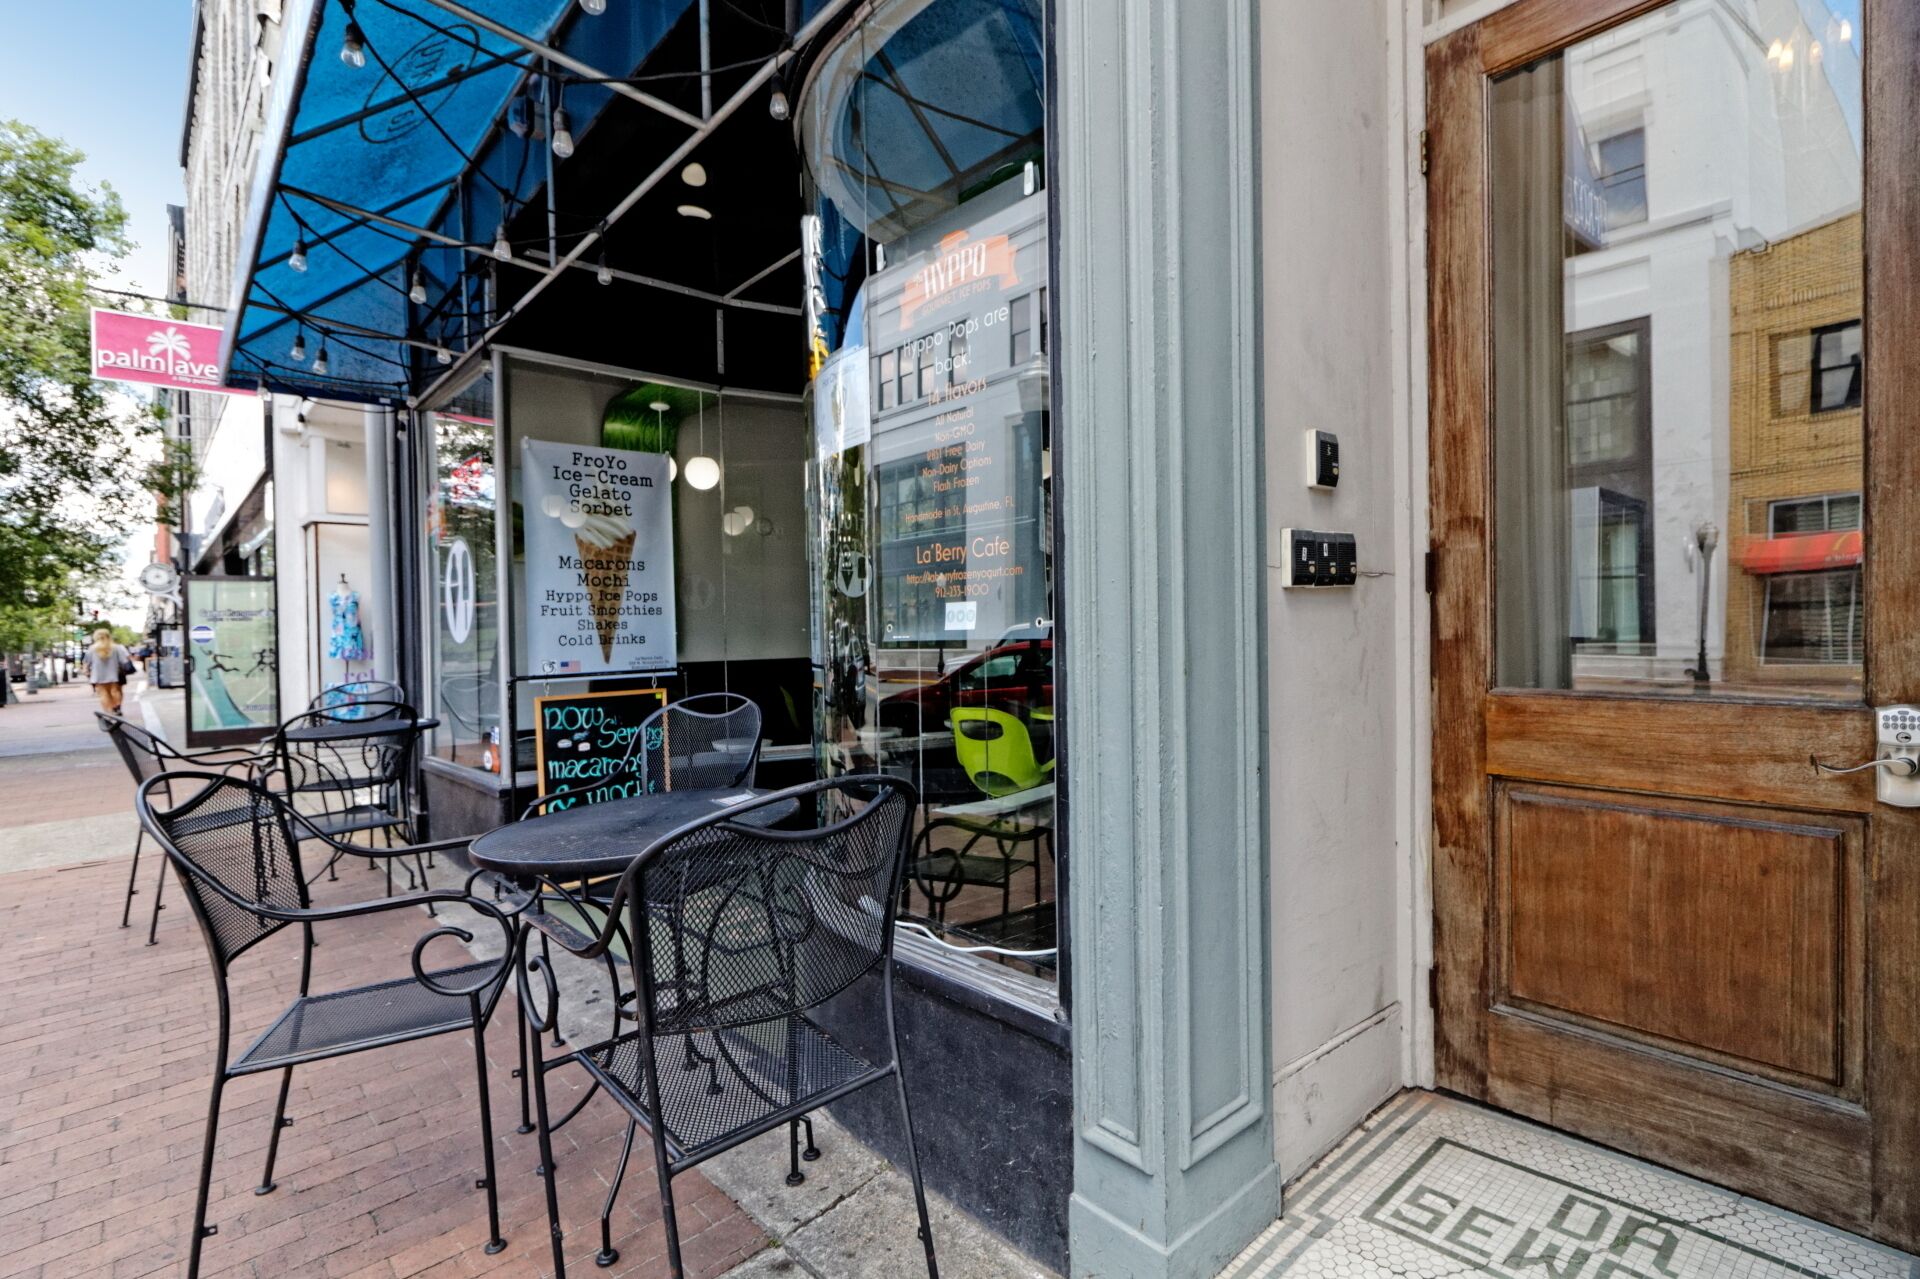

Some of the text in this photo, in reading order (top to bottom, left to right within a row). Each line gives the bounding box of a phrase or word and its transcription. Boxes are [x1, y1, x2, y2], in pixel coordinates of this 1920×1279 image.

[924, 243, 986, 299] HYPPO
[903, 307, 1009, 360] Hyppo Pops are
[936, 344, 972, 375] back!
[945, 378, 986, 400] flavors
[947, 406, 974, 423] Natural
[936, 423, 975, 442] Non-GMO
[966, 440, 985, 452] Dairy
[572, 452, 627, 470] FroYo
[960, 456, 992, 471] Options
[553, 465, 653, 487] Ice-Cream
[569, 484, 632, 501] Gelato
[570, 500, 633, 516] Sorbet
[972, 536, 1010, 558] Cafe
[559, 555, 645, 571] Macarons
[577, 573, 631, 587] Mochi
[546, 590, 658, 603] Hyppo Ice Pops
[541, 604, 663, 617] Fruit Smoothies
[577, 619, 628, 631] Shakes
[558, 633, 646, 646] Cold Drinks
[544, 706, 605, 731] now
[598, 717, 664, 750] Serng
[1390, 1184, 1660, 1279] SEW
